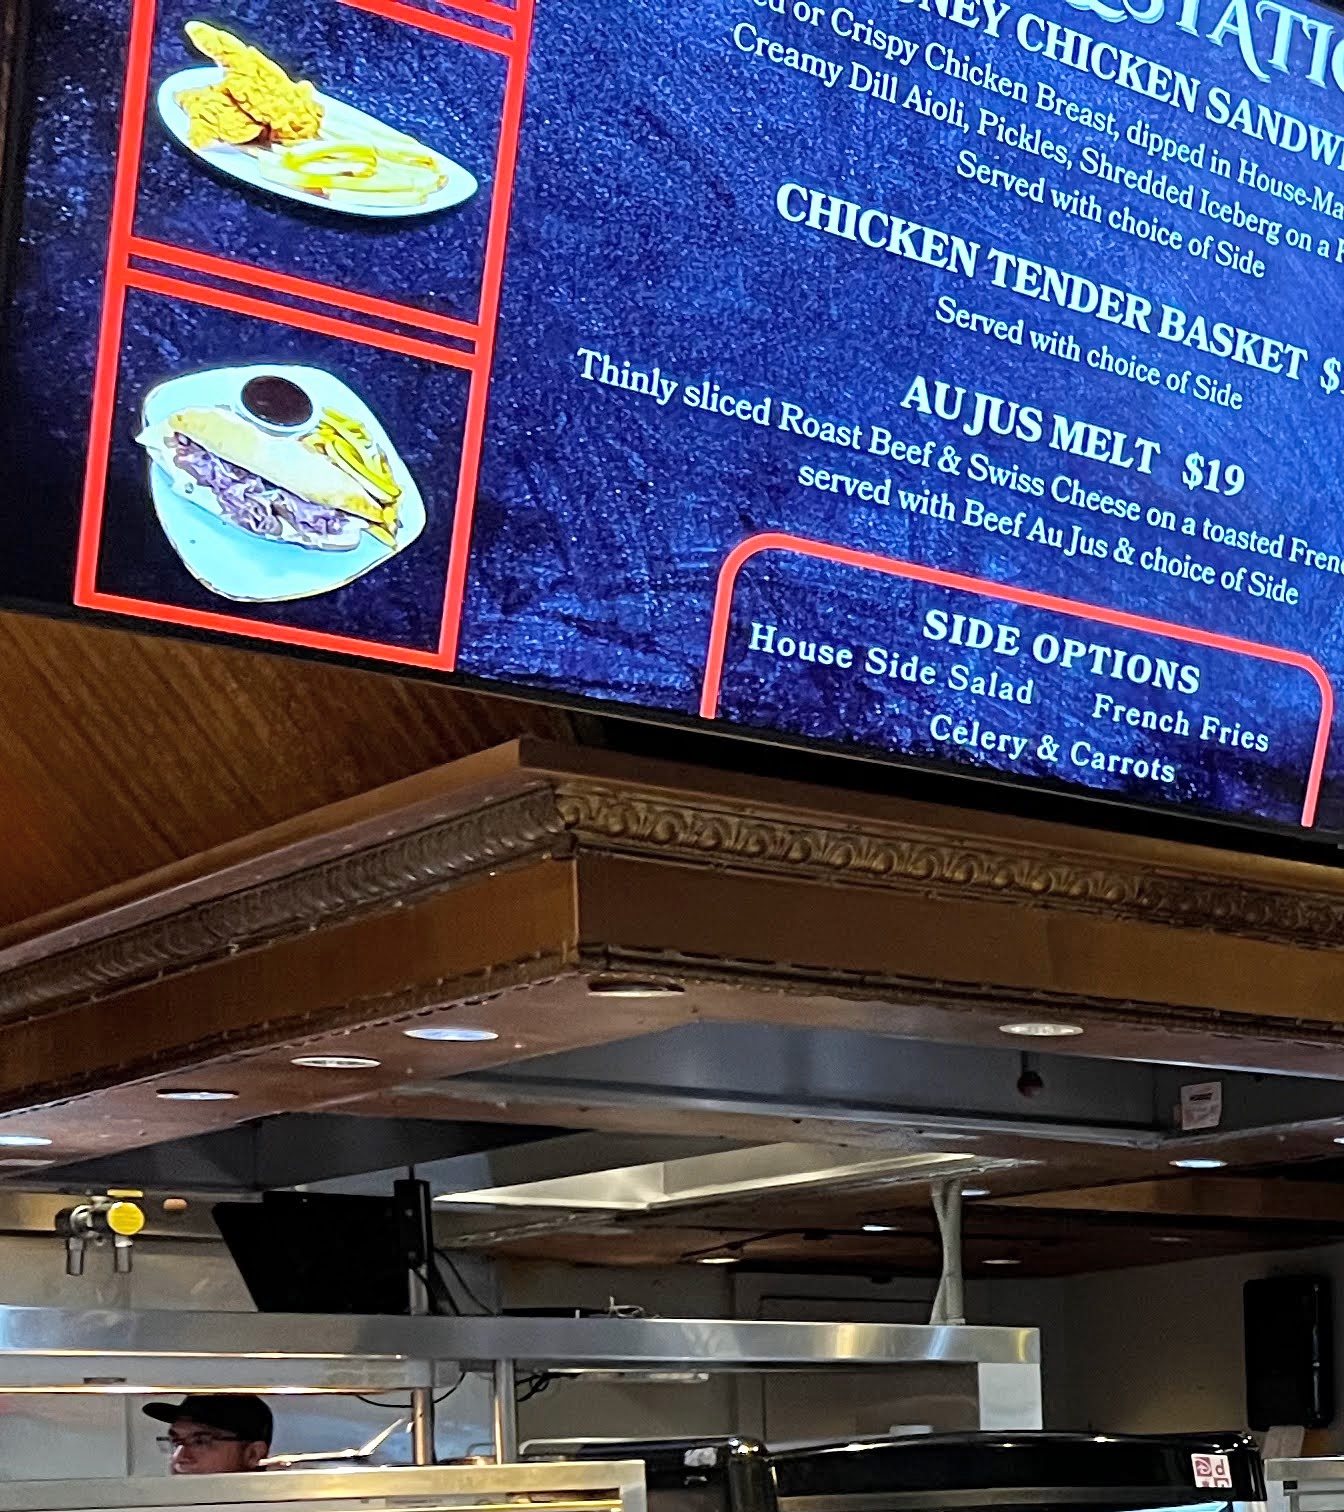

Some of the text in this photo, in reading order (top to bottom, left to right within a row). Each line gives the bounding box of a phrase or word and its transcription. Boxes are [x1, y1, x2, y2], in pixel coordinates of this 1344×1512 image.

[793, 1, 826, 27] or
[831, 6, 920, 66] Crispy
[924, 41, 1028, 104] Chicken
[1034, 81, 1120, 142] Breast,
[1126, 119, 1206, 169] dipped
[1209, 149, 1231, 179] in
[1016, 13, 1201, 113] CHICKEN
[733, 21, 844, 88] Creamy
[848, 61, 898, 104] Dill
[902, 84, 970, 134] Aioli,
[976, 107, 1073, 171] Pickles,
[1079, 146, 1194, 210] Shredded
[1198, 188, 1283, 246] Iceberg
[1285, 228, 1312, 252] on
[1317, 239, 1330, 258] a
[956, 149, 1266, 278] Served with choice of Side
[776, 183, 981, 278] CHICKEN
[987, 247, 1152, 334] TENDER
[1157, 304, 1309, 380] BASKET
[935, 295, 1243, 410] Served with choice of Side
[577, 347, 679, 406] Thinly
[683, 380, 772, 426] sliced
[778, 401, 863, 450] Roast
[867, 425, 937, 468] Beef
[937, 445, 962, 476] &
[967, 453, 1045, 497] Swiss
[1051, 475, 1141, 522] Cheese
[1146, 507, 1176, 531] on
[1181, 517, 1196, 536] a
[1202, 518, 1285, 559] toasted
[900, 375, 1245, 496] AU JUS MELT $19
[797, 465, 1299, 605] served with Beef Au Jus & choice of Side
[748, 622, 1034, 705] House Side Salad
[923, 609, 1200, 694] SIDE OPTIONS
[930, 713, 1175, 783] Celery & Carrots
[1091, 693, 1269, 752] French Fries
